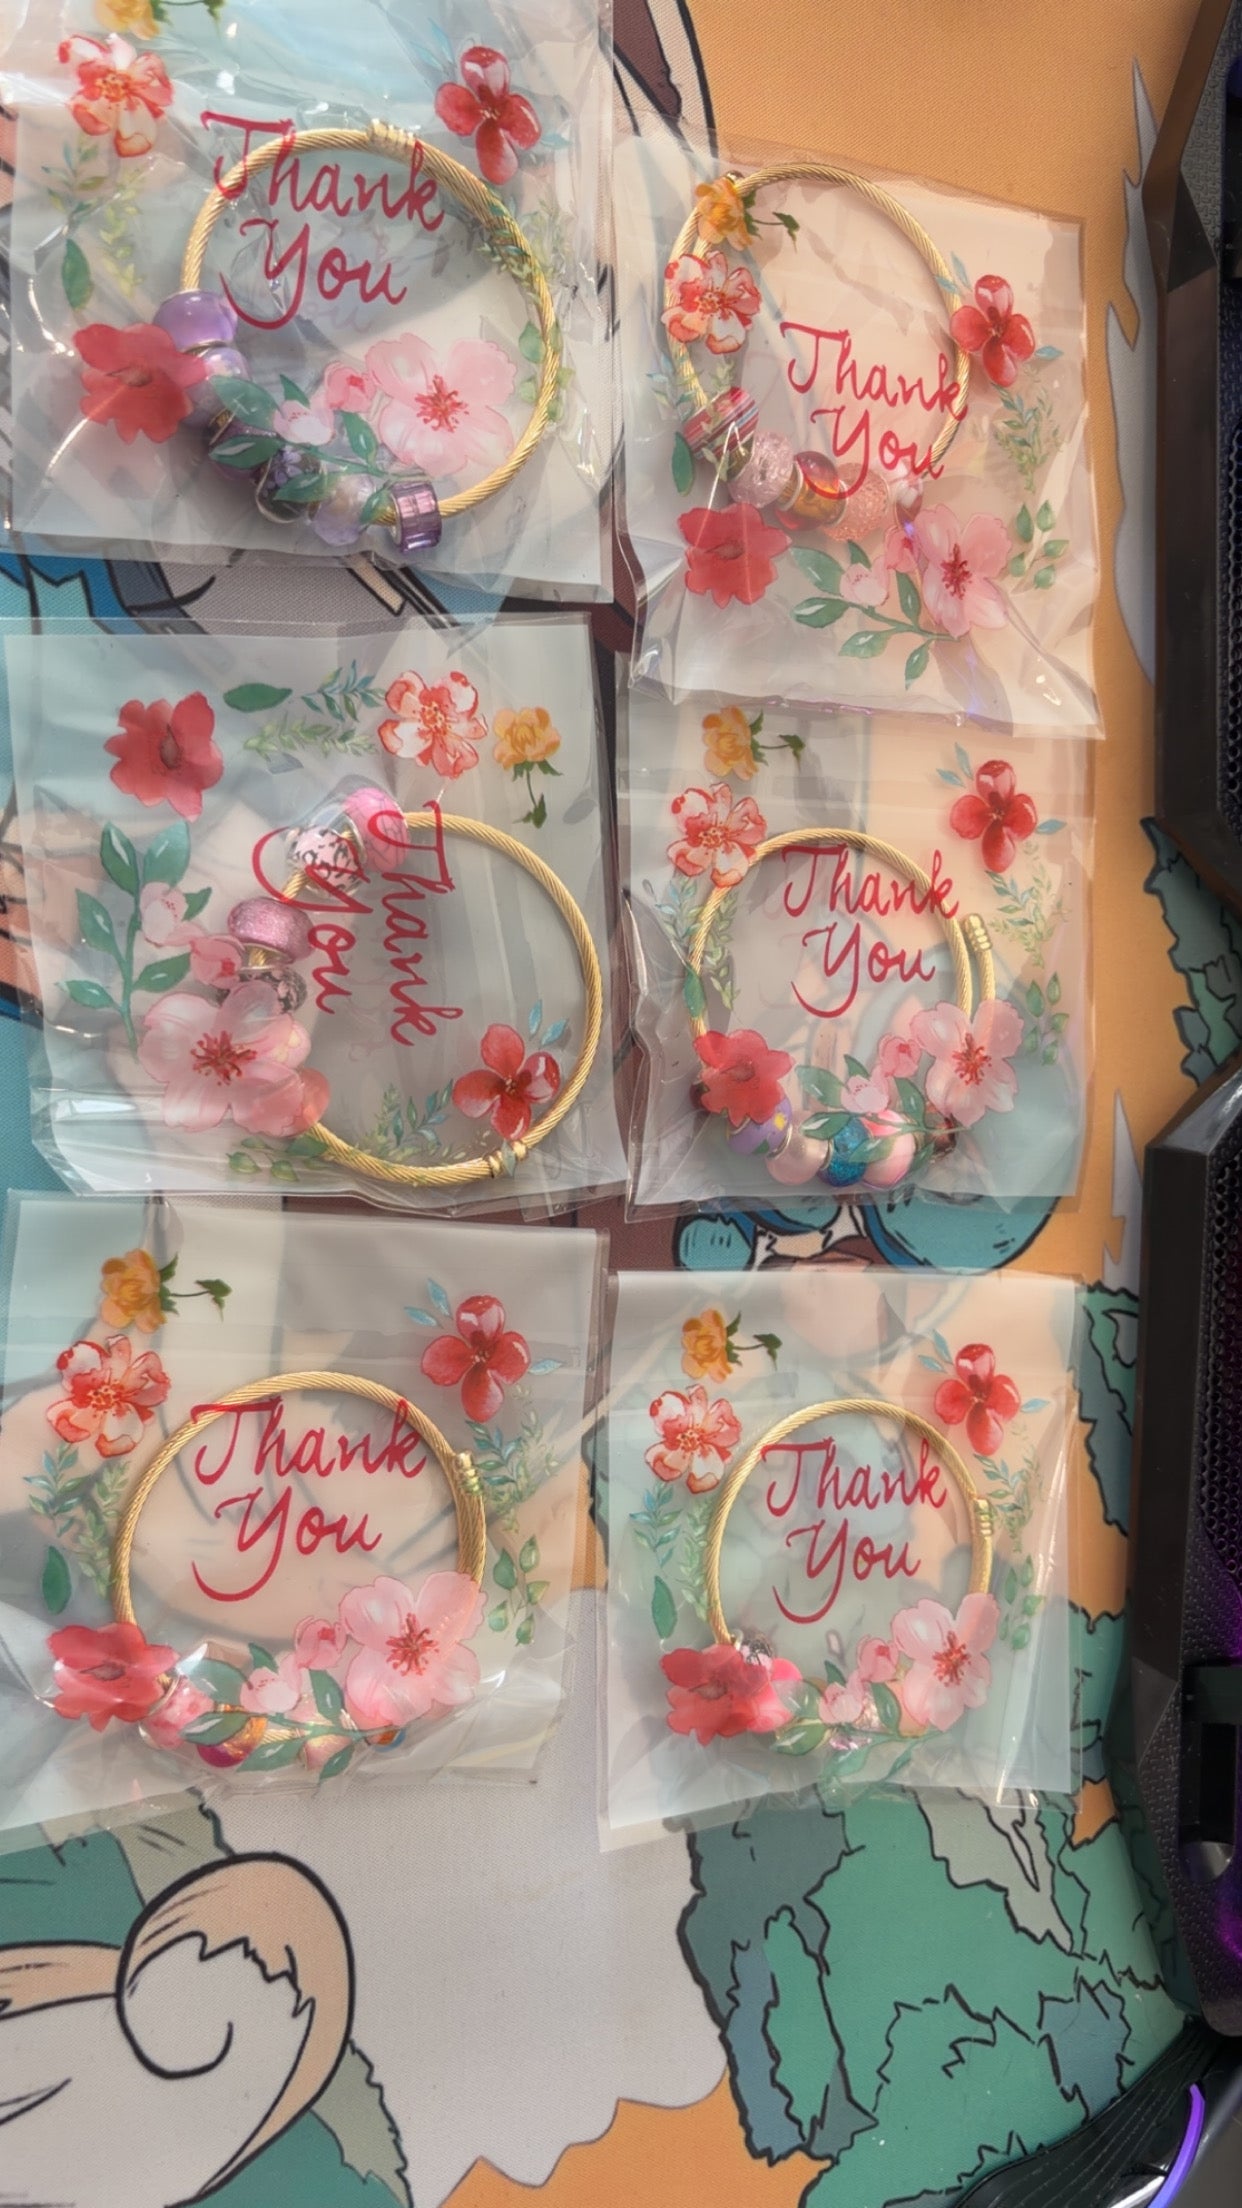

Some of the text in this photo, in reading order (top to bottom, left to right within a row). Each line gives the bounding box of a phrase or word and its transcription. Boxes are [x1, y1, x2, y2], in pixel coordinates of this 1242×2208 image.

[201, 111, 444, 231] Thank
[220, 218, 407, 330] You
[780, 322, 968, 421] Thank
[796, 405, 944, 498] You
[251, 826, 372, 1015] You
[367, 800, 463, 1046] Thank
[781, 843, 960, 919] Thank
[790, 921, 935, 1018] You
[191, 1396, 428, 1486] Thank
[760, 1436, 947, 1517] Thank
[192, 1486, 383, 1601] You
[772, 1518, 921, 1624] You
